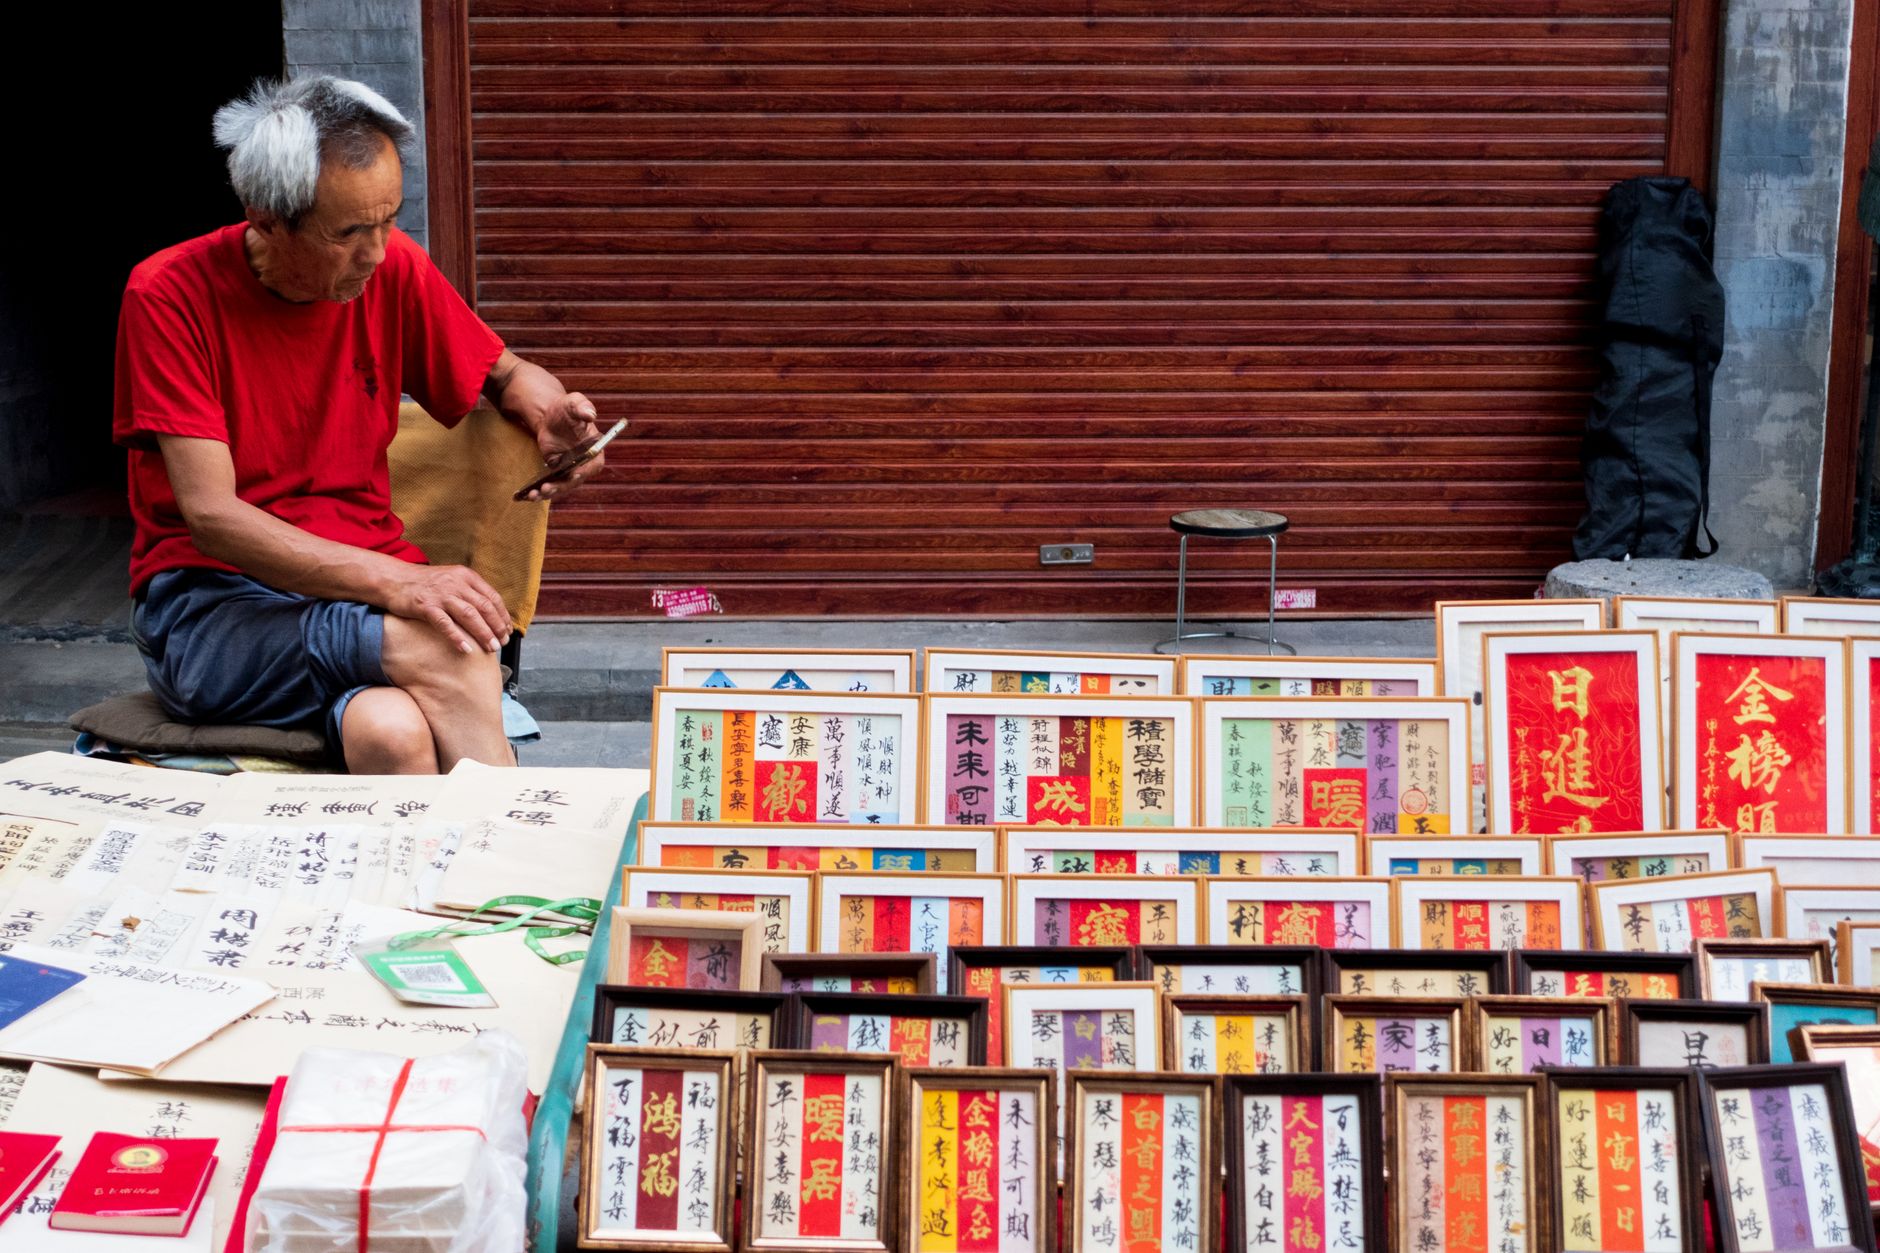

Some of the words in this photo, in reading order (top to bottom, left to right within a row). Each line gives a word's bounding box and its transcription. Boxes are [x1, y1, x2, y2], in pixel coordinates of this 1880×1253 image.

[676, 715, 696, 790] 春祺夏安
[789, 717, 815, 757] 安康
[1030, 719, 1054, 774] 前程似錦
[762, 763, 807, 821] 歡
[823, 717, 844, 818] 萬事順遂
[1277, 721, 1299, 824] 萬事順遂
[1033, 781, 1086, 826] 成
[1311, 778, 1365, 828] 暖
[1624, 904, 1650, 952] 幸
[643, 939, 678, 985] 金
[696, 943, 733, 985] 前
[617, 1014, 646, 1044] 金
[688, 1018, 721, 1049] 前
[935, 1021, 960, 1066] 財
[766, 1080, 797, 1225] 平安喜樂
[802, 1094, 845, 1204] 暖居
[922, 1094, 955, 1237] 逢考必過
[959, 1096, 993, 1241] 金榜題名
[1285, 1102, 1323, 1250] 天官賜福
[1327, 1105, 1364, 1248] 百無禁忌
[1604, 1102, 1635, 1233] 日富一日
